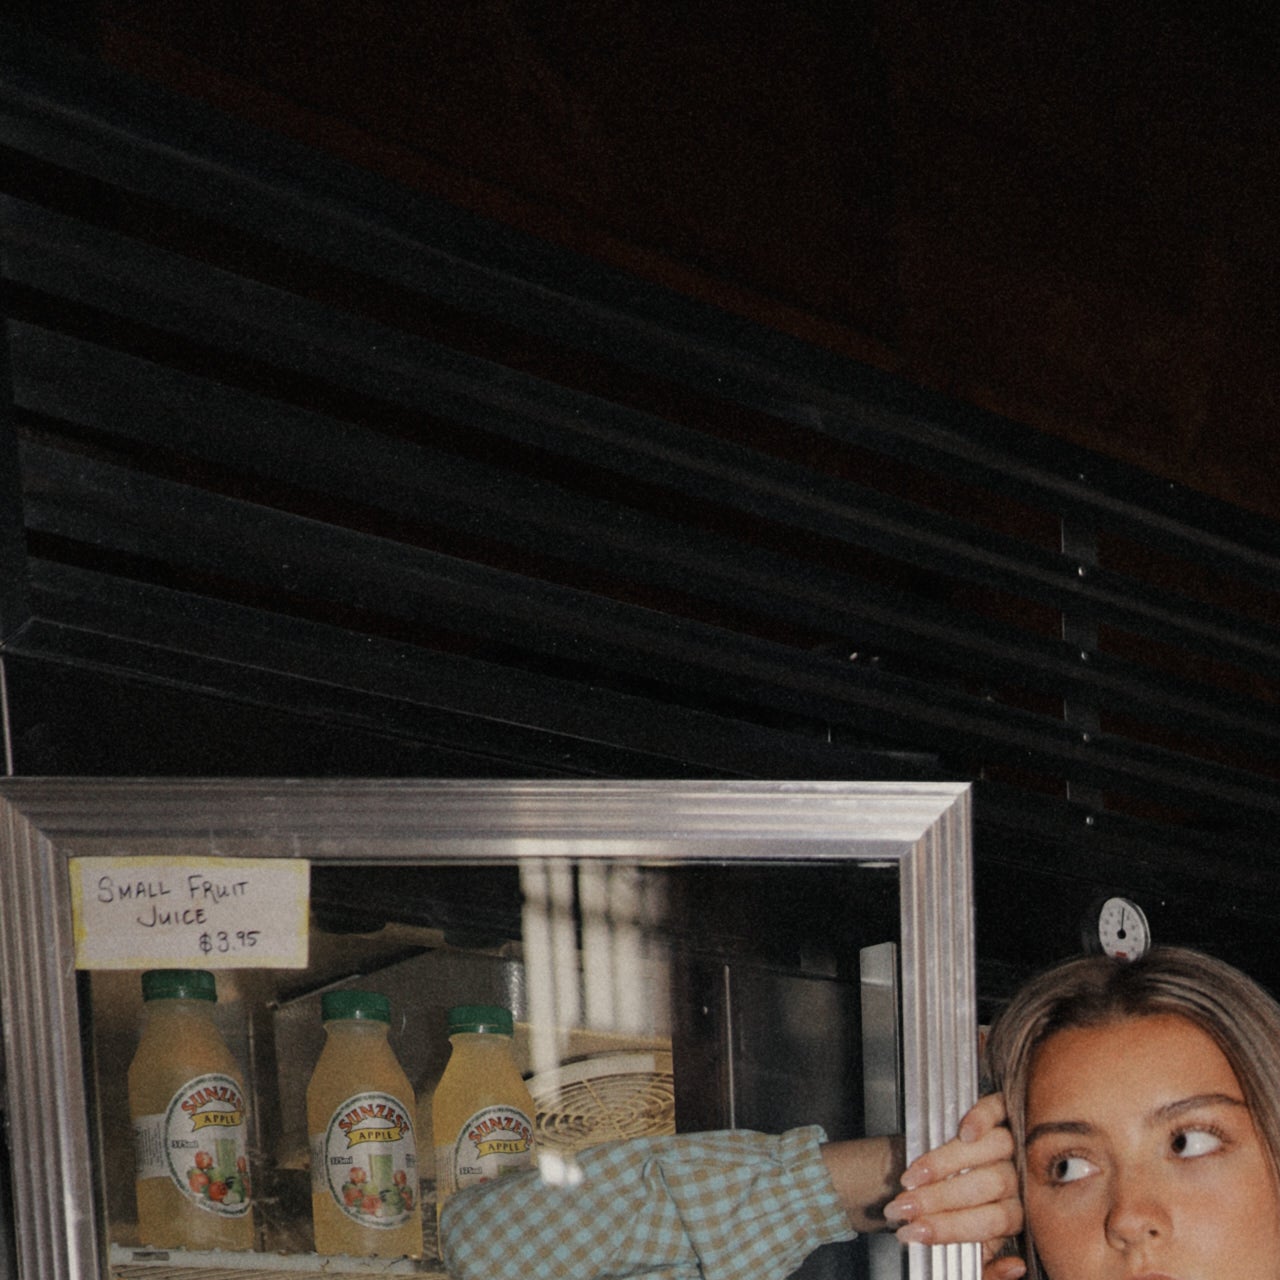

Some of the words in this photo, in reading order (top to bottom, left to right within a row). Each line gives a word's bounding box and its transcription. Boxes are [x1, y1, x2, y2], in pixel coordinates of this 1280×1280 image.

[97, 876, 171, 903] SMALL
[187, 874, 250, 905] FRUIT
[136, 905, 208, 928] JUICE
[198, 931, 261, 955] $3.95
[203, 1114, 236, 1125] APPLE
[359, 1131, 393, 1141] APPLE
[488, 1142, 520, 1153] APPLE
